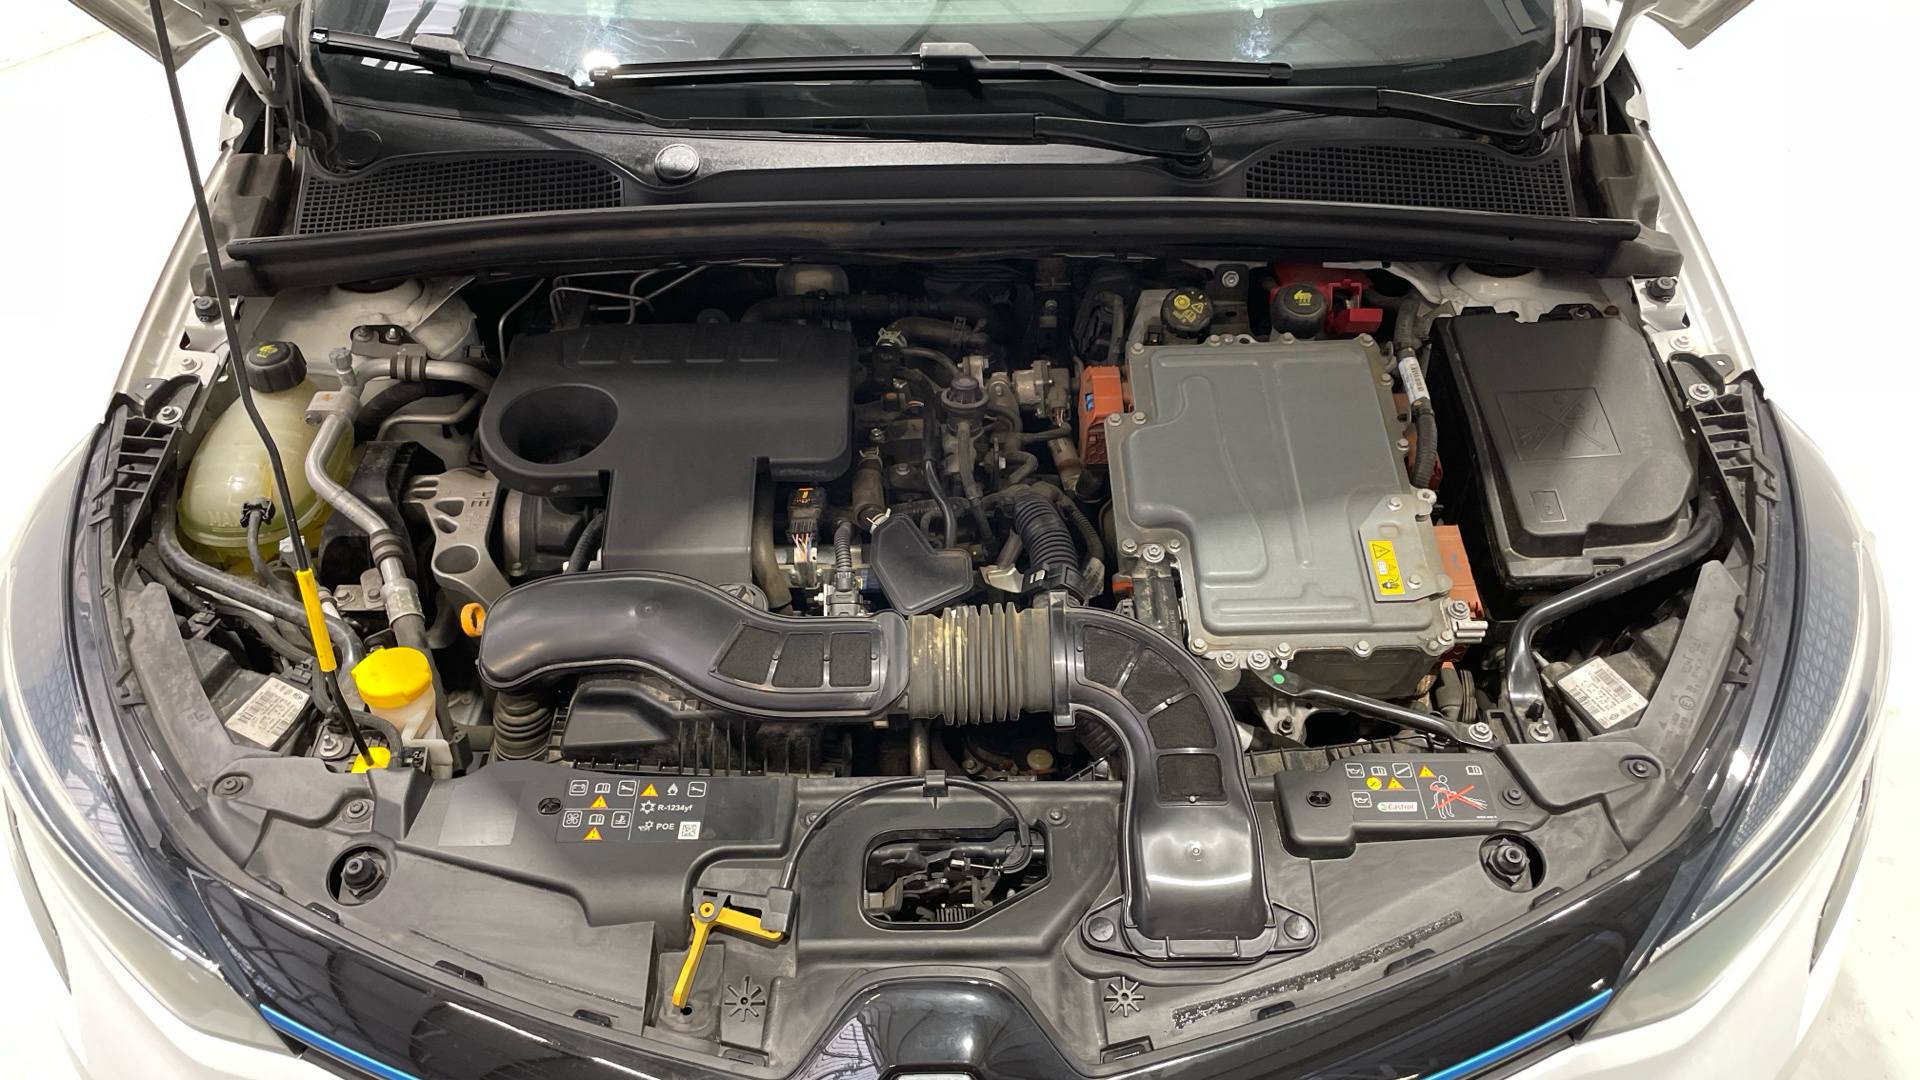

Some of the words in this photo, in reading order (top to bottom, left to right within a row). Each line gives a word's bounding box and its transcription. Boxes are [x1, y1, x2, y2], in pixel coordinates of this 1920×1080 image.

[657, 804, 693, 813] R-1234yf
[1387, 803, 1414, 811] Castrol
[656, 823, 675, 831] POE
